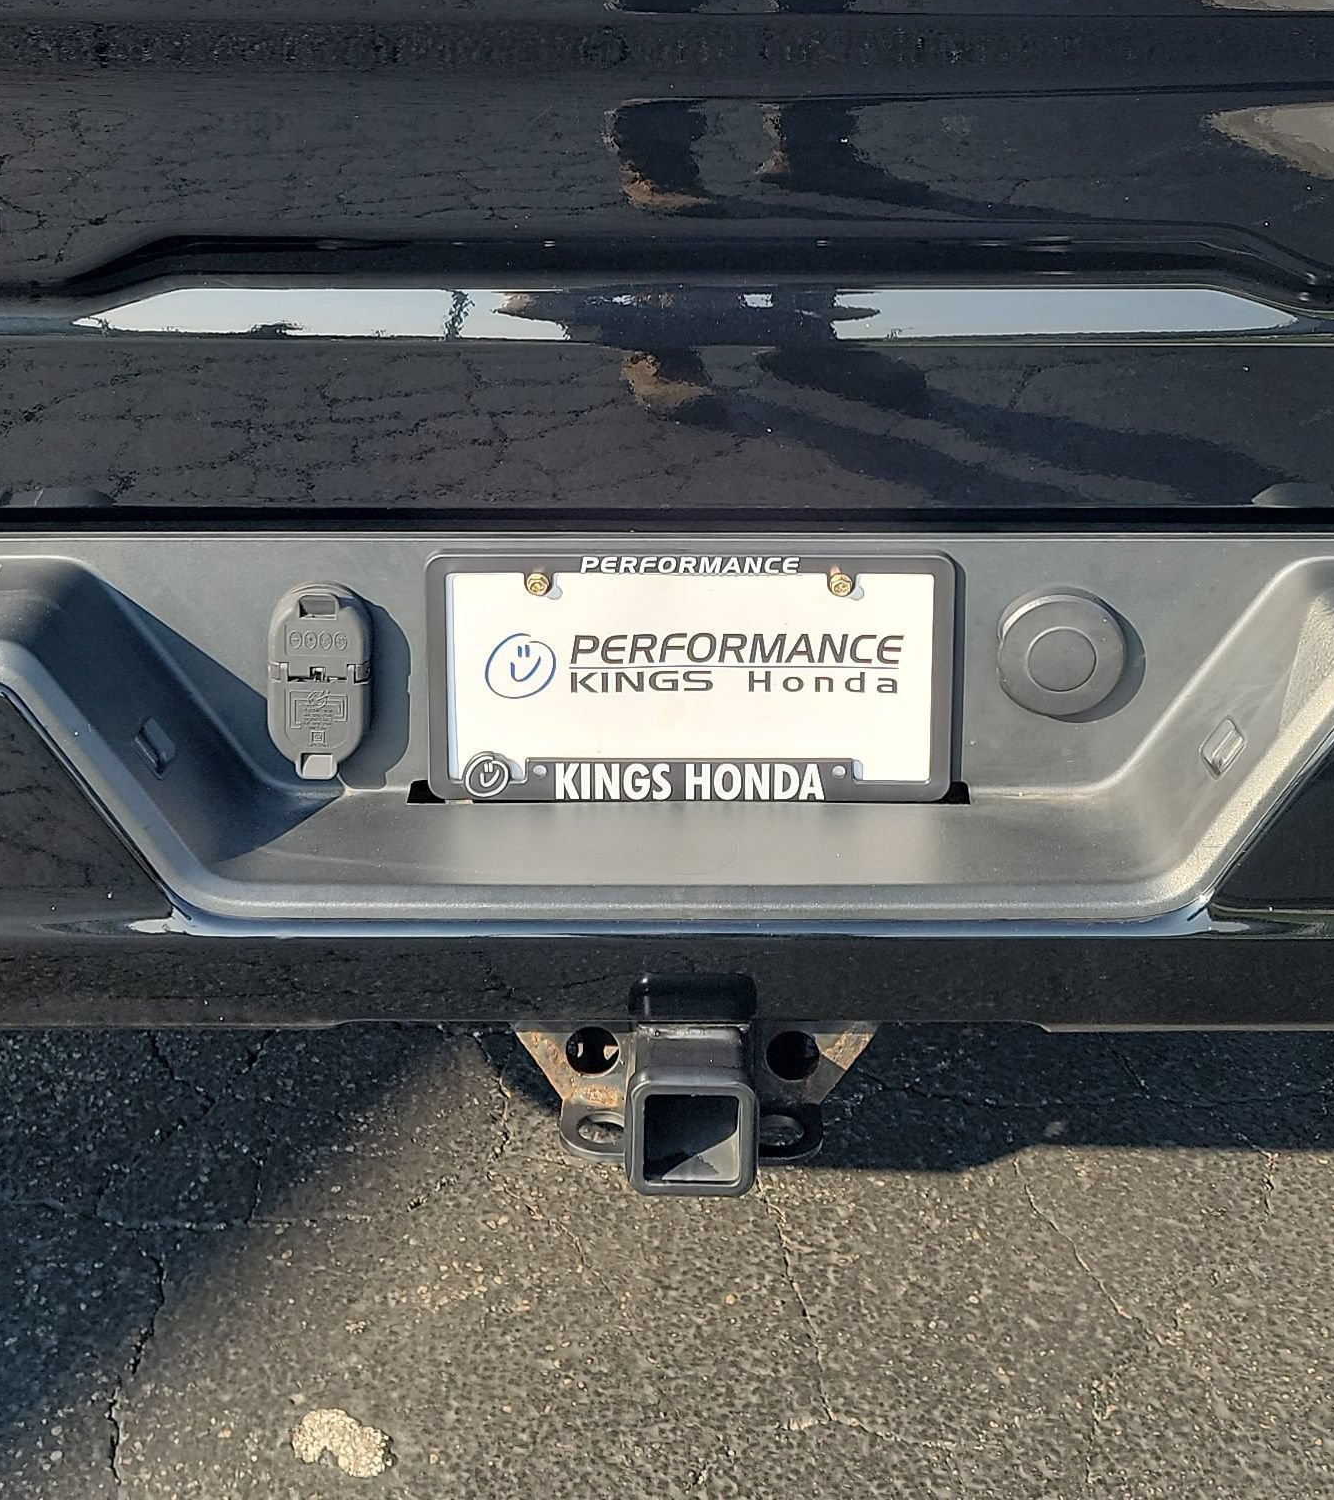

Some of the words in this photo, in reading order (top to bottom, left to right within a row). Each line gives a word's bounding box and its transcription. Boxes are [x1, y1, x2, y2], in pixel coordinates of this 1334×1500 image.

[580, 556, 801, 575] PERFORMANCE
[570, 632, 905, 665] PERFORMANCE
[569, 671, 714, 694] KINGS
[748, 671, 899, 695] Honda
[555, 762, 673, 800] KINGS
[685, 762, 825, 800] HONDA
